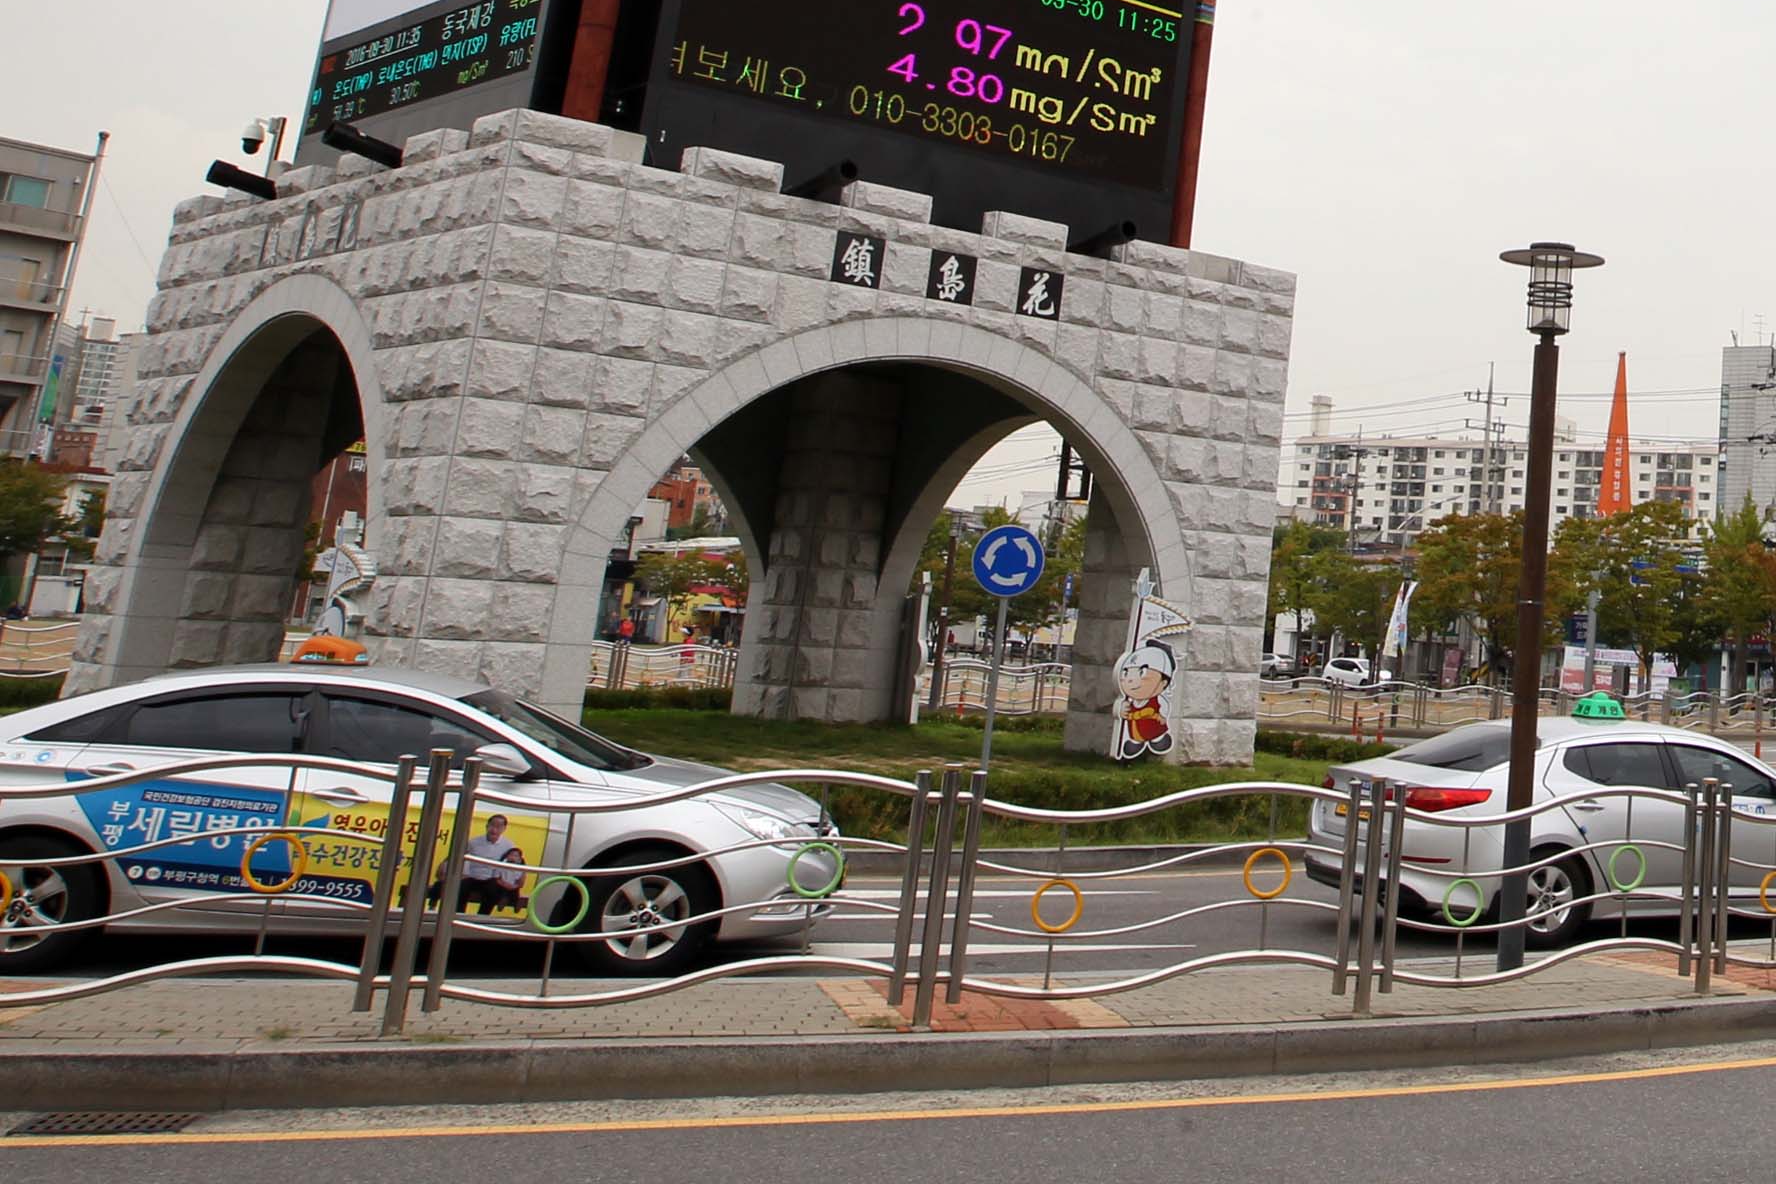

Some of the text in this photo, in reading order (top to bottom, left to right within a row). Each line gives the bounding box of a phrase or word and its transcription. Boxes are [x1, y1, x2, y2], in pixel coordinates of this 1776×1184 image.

[440, 0, 497, 41] 동국제강
[1118, 7, 1177, 43] 11:25
[887, 52, 1005, 105] 4.80
[849, 84, 1077, 163] 010-3303-0167
[102, 800, 131, 846] 부평
